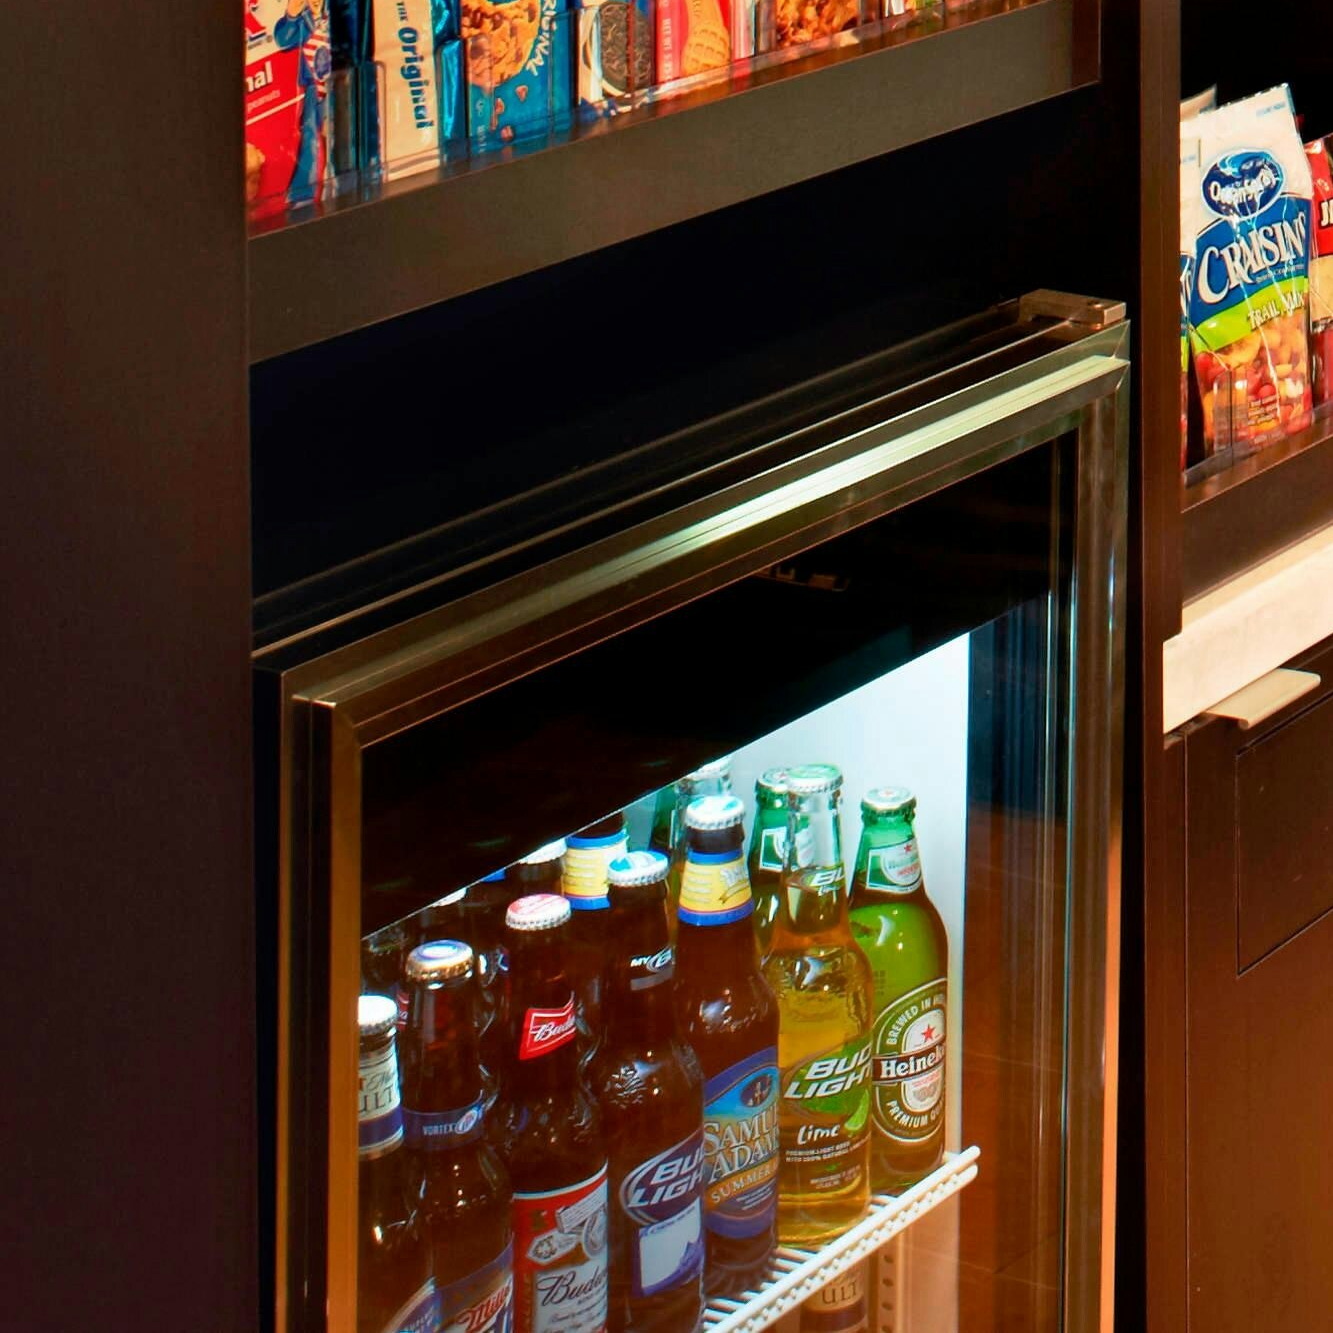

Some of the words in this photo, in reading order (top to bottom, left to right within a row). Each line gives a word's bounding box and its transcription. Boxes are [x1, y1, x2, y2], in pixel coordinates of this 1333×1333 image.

[398, 26, 435, 130] Original
[1248, 301, 1279, 330] TRAIL
[886, 1005, 919, 1046] BREWED
[886, 1099, 930, 1129] PREMIUM
[796, 1125, 840, 1146] Lime
[710, 1165, 771, 1204] SUMMER
